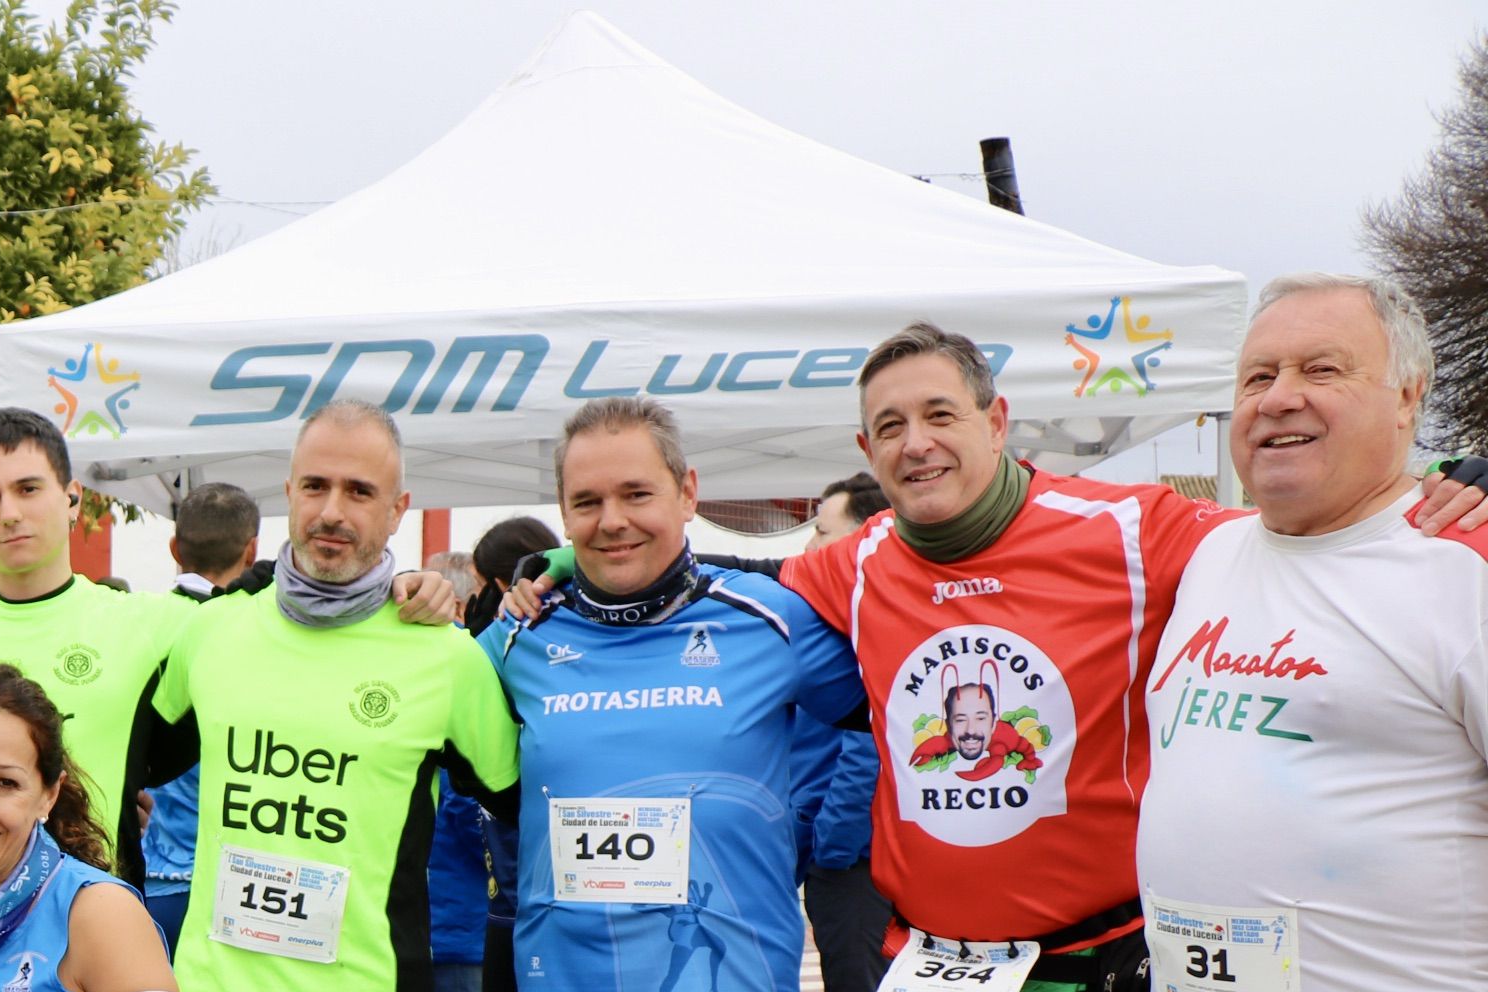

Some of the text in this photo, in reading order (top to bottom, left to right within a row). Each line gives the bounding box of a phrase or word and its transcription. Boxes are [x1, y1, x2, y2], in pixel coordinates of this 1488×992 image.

[190, 334, 551, 427] SDM
[904, 636, 1045, 697] MARISCOS
[542, 685, 724, 716] TROTASIERRA
[227, 726, 359, 786] Uber
[921, 786, 1029, 810] RECIO
[222, 782, 348, 844] Eats
[562, 818, 586, 827] Ciudad
[588, 818, 597, 827] de
[599, 818, 629, 827] Lucena
[576, 810, 611, 818] Silvestre
[576, 832, 655, 861] 140
[230, 864, 291, 885] Ciudad de Lucena
[244, 858, 277, 873] Silvestre
[634, 880, 672, 888] enerplus
[240, 882, 308, 920] 151
[1156, 922, 1181, 935] Ciudad
[1181, 926, 1192, 936] de
[1193, 928, 1223, 941] Lucena
[1170, 913, 1204, 929] Silvestre
[288, 935, 324, 947] enerplus
[914, 961, 996, 984] 364
[1186, 944, 1236, 982] 31
